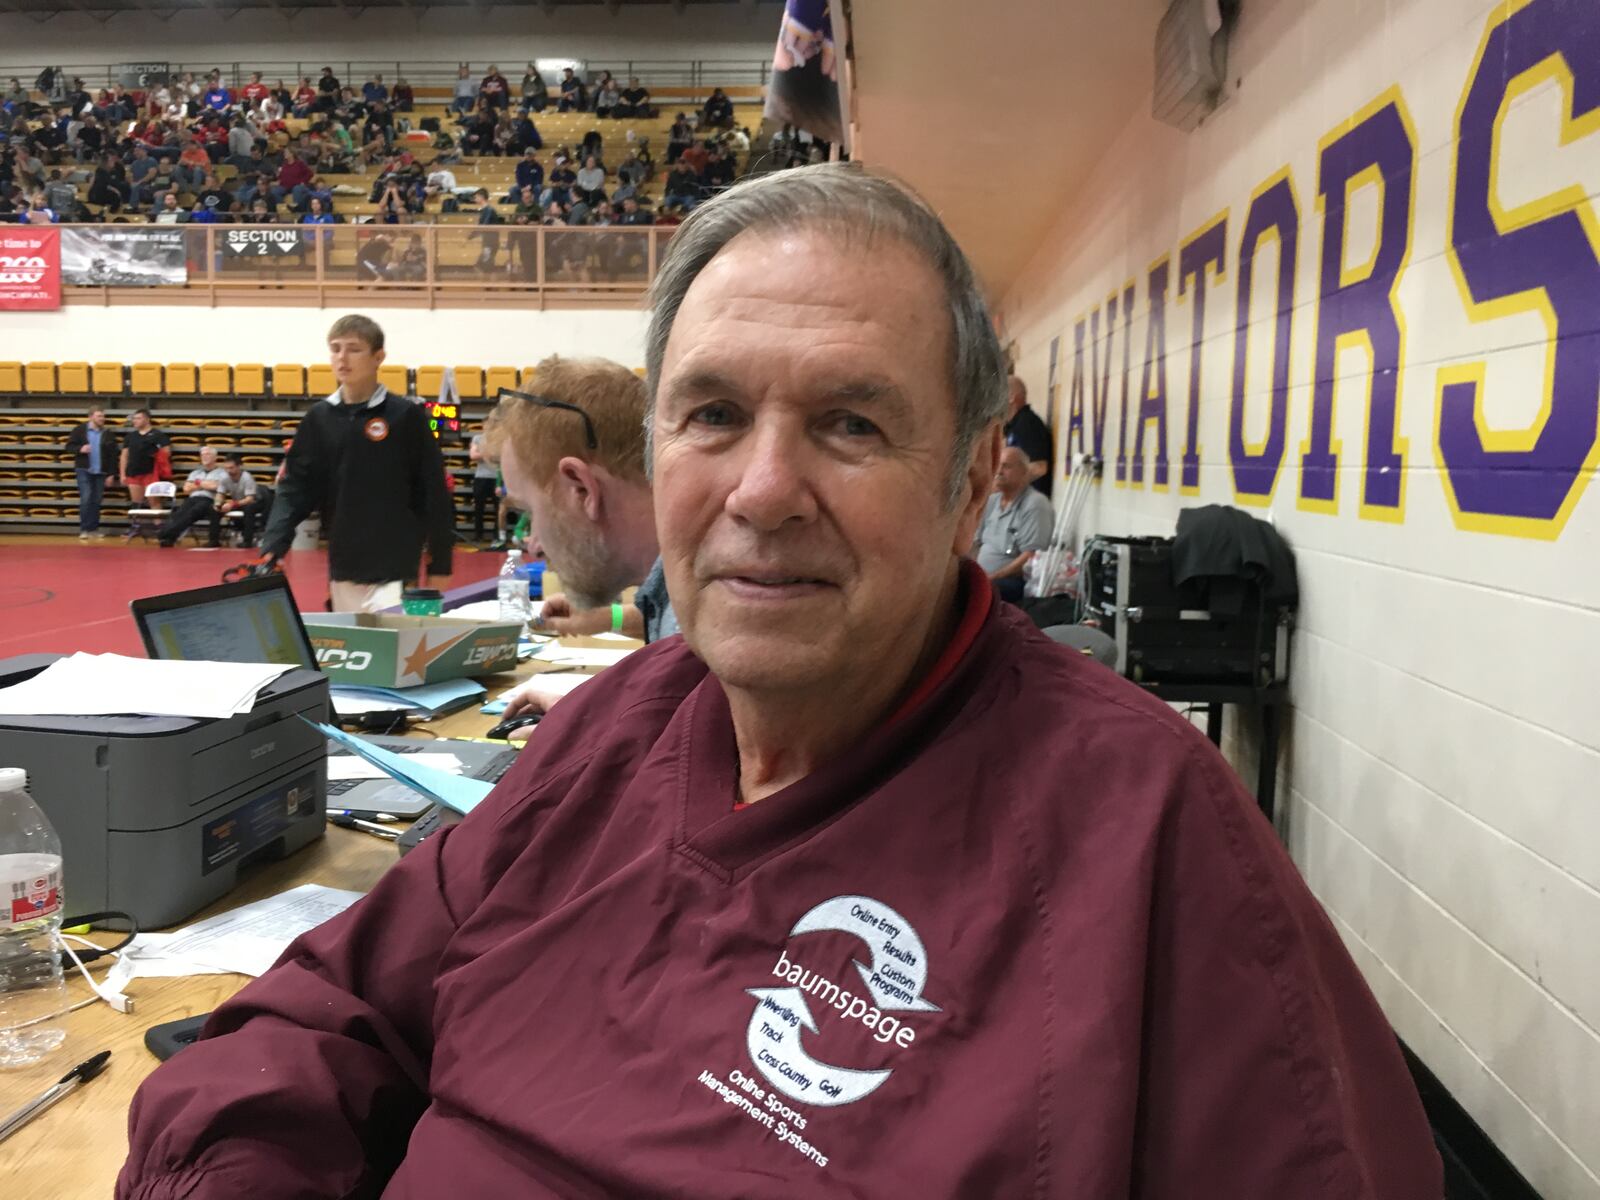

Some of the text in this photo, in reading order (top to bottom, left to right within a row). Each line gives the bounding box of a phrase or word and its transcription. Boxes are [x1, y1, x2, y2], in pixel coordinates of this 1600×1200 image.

[228, 230, 297, 242] SECTION
[257, 243, 268, 255] 2
[1064, 0, 1600, 541] AVIATORS
[851, 904, 901, 940] Online Entry
[882, 941, 917, 967] Results
[870, 972, 914, 1005] Programs
[880, 963, 916, 990] Custom
[772, 950, 915, 1049] baumspage
[759, 1021, 785, 1043] Track
[757, 1048, 843, 1098] Cross Country Golf
[729, 1070, 808, 1130] Online Sports
[697, 1070, 830, 1168] Management Systems
